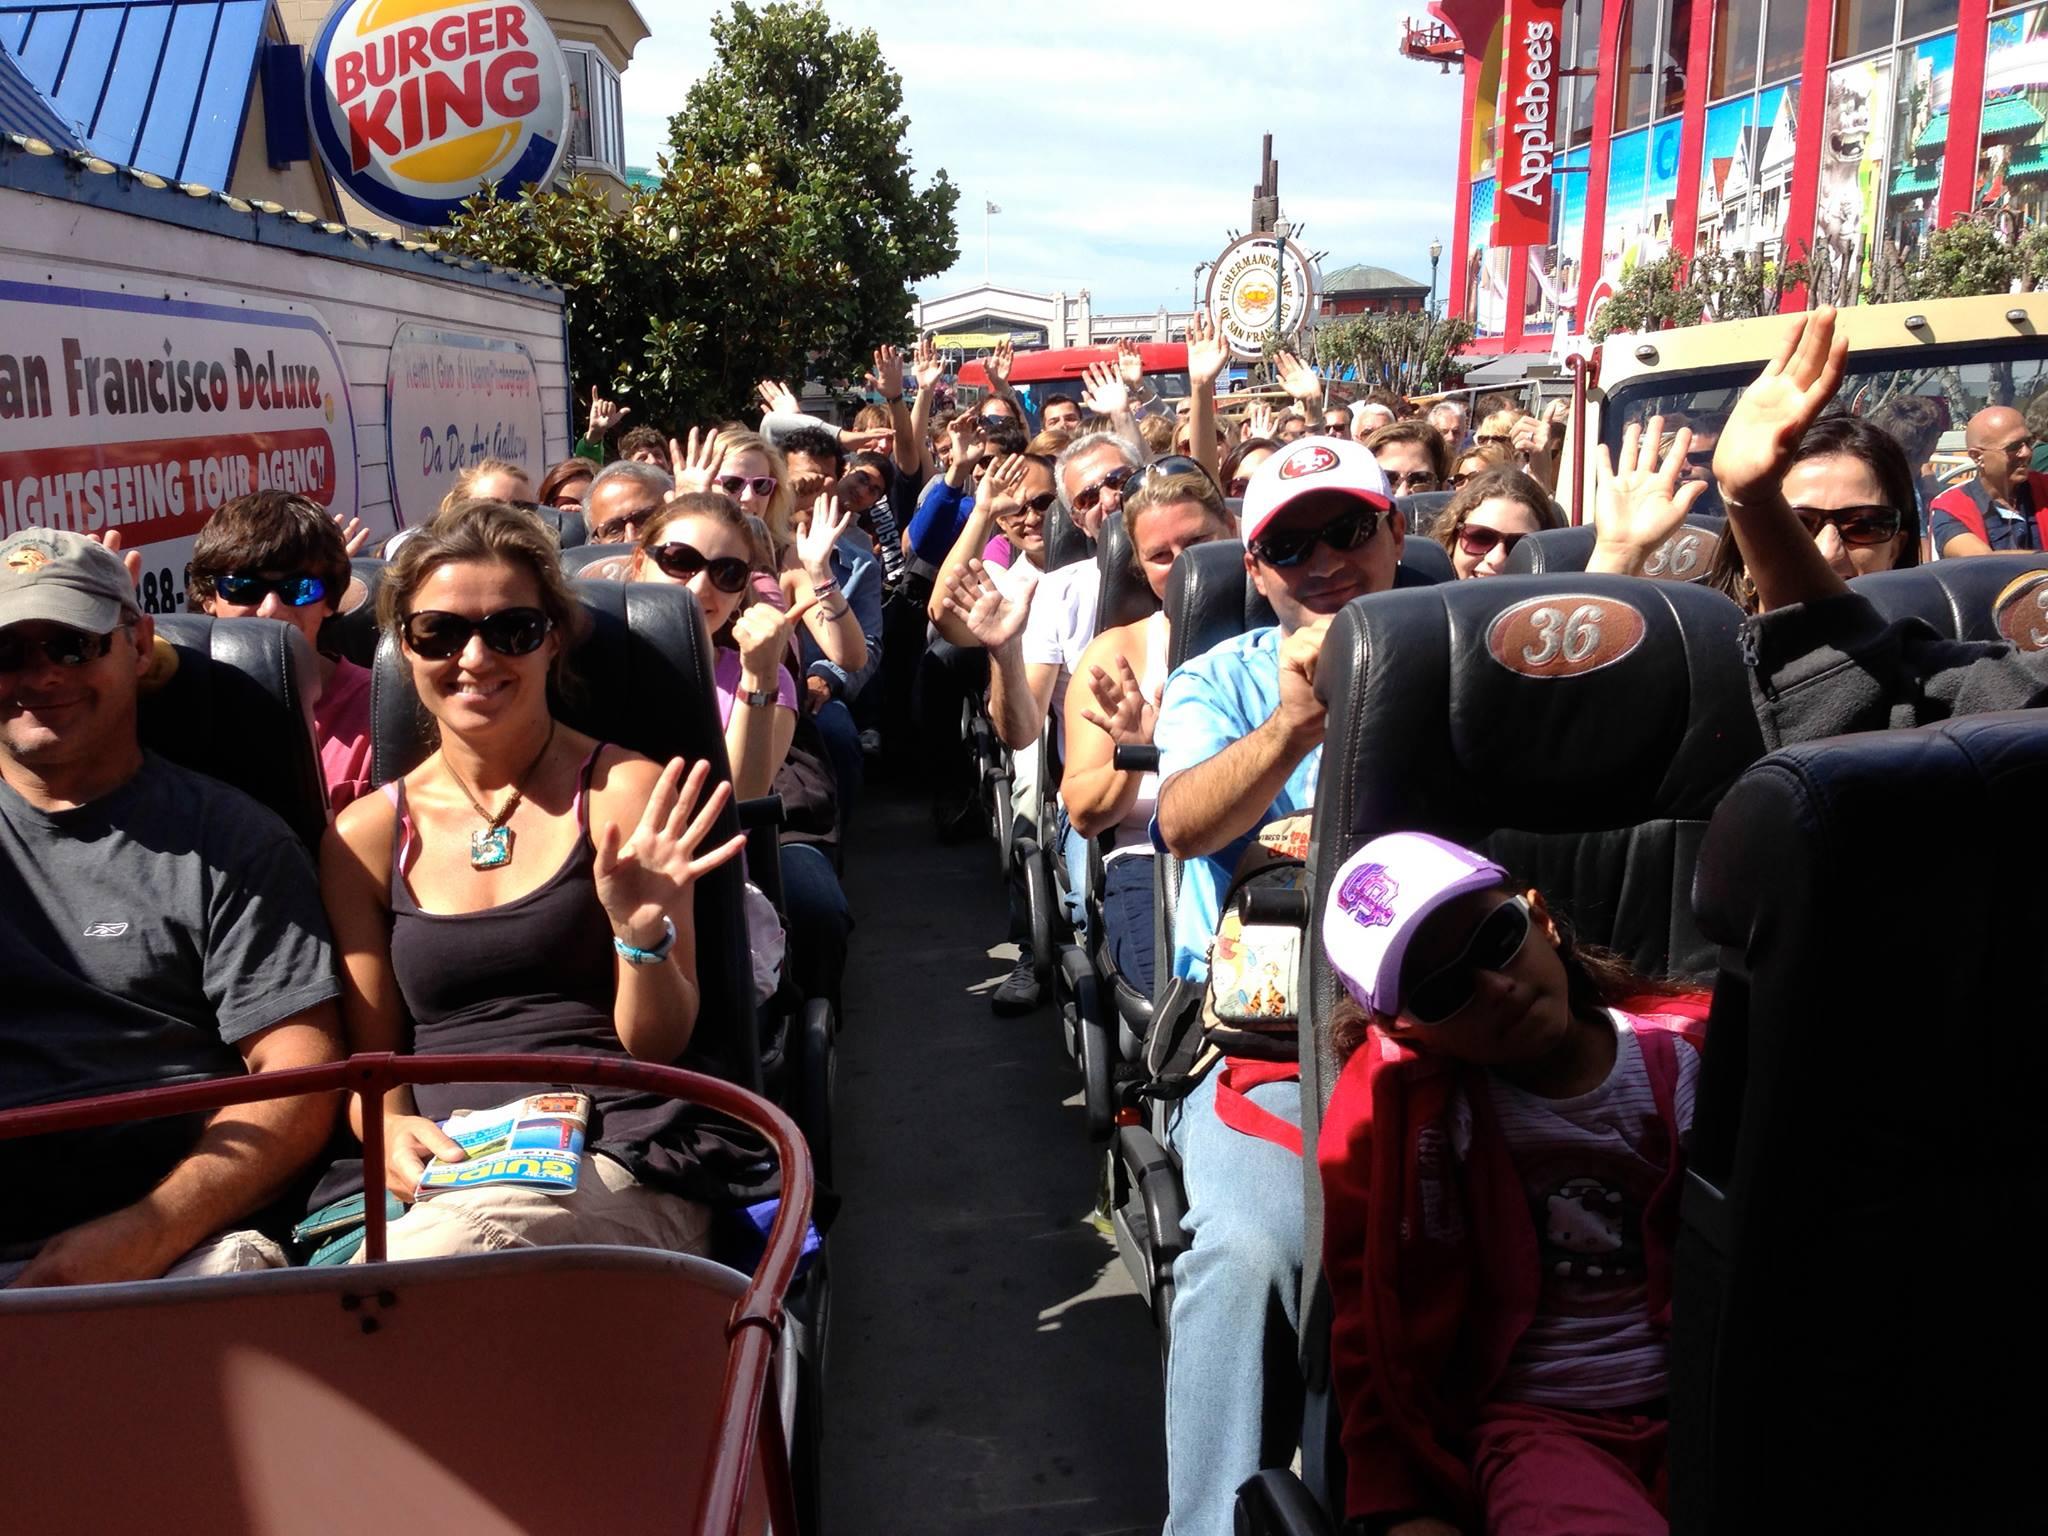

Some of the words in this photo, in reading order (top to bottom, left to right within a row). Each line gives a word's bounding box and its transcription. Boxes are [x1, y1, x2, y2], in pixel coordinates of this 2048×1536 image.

[335, 5, 530, 105] BURGER
[348, 50, 540, 173] KING
[1504, 20, 1554, 206] Applebee's
[1219, 253, 1272, 302] FISHERMANS
[1270, 256, 1294, 298] WARF
[1227, 320, 1245, 341] SAN
[61, 337, 229, 418] Francisco
[233, 347, 322, 412] DeLuxe
[188, 454, 251, 512] TOUR
[257, 445, 325, 493] AGENCY
[420, 425, 444, 477] Da
[446, 423, 467, 472] De
[1643, 534, 1701, 576] 36
[1522, 604, 1605, 667] 36
[426, 1158, 574, 1185] GUIDE
